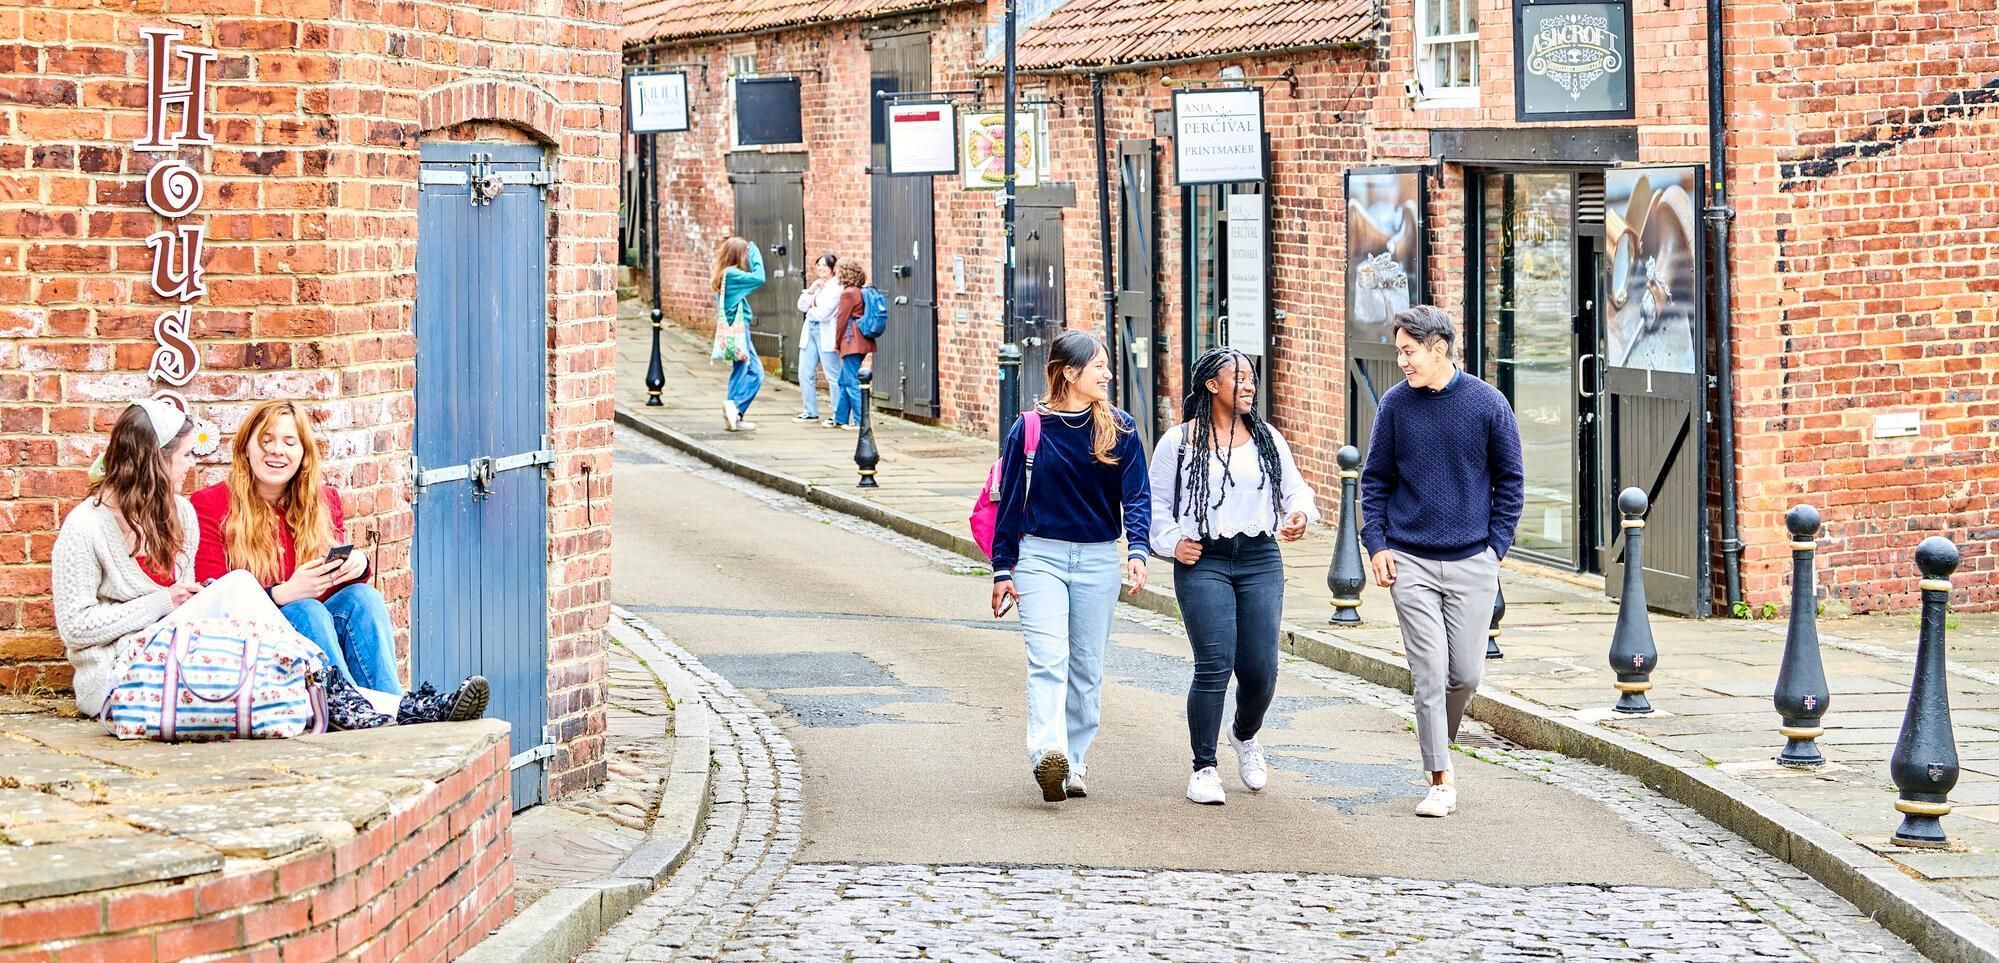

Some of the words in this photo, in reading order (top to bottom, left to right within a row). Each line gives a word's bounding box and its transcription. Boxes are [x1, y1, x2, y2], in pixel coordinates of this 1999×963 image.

[1533, 25, 1618, 54] ASHCROFT
[1183, 103, 1213, 114] ANJA
[1184, 120, 1256, 134] PERCIVAL
[1184, 144, 1257, 156] PRINTMAKER
[1140, 168, 1146, 193] 2
[787, 223, 793, 241] 5
[913, 240, 919, 260] 4
[1048, 265, 1054, 288] 3
